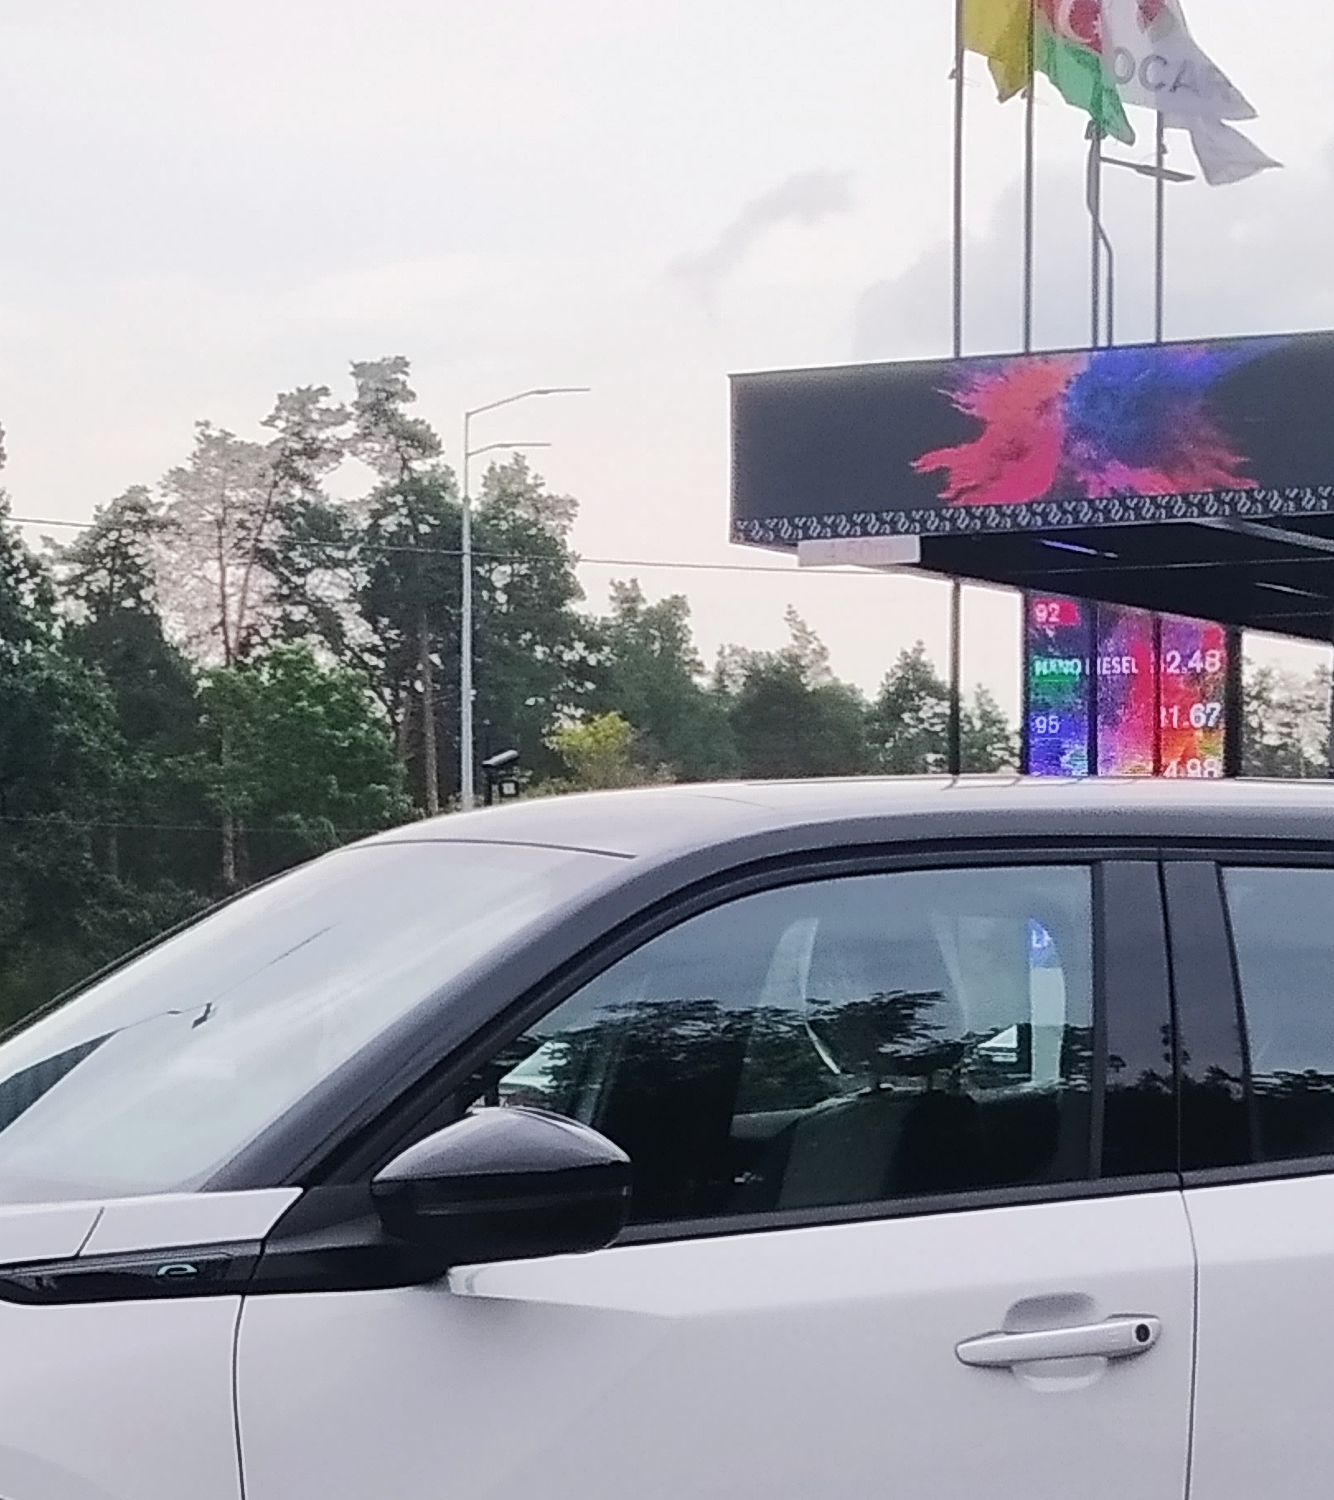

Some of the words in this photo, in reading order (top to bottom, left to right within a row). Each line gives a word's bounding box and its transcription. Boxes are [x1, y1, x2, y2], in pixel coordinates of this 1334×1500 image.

[1034, 603, 1061, 623] 92
[1159, 649, 1222, 674] 2.48
[1035, 715, 1061, 734] 95
